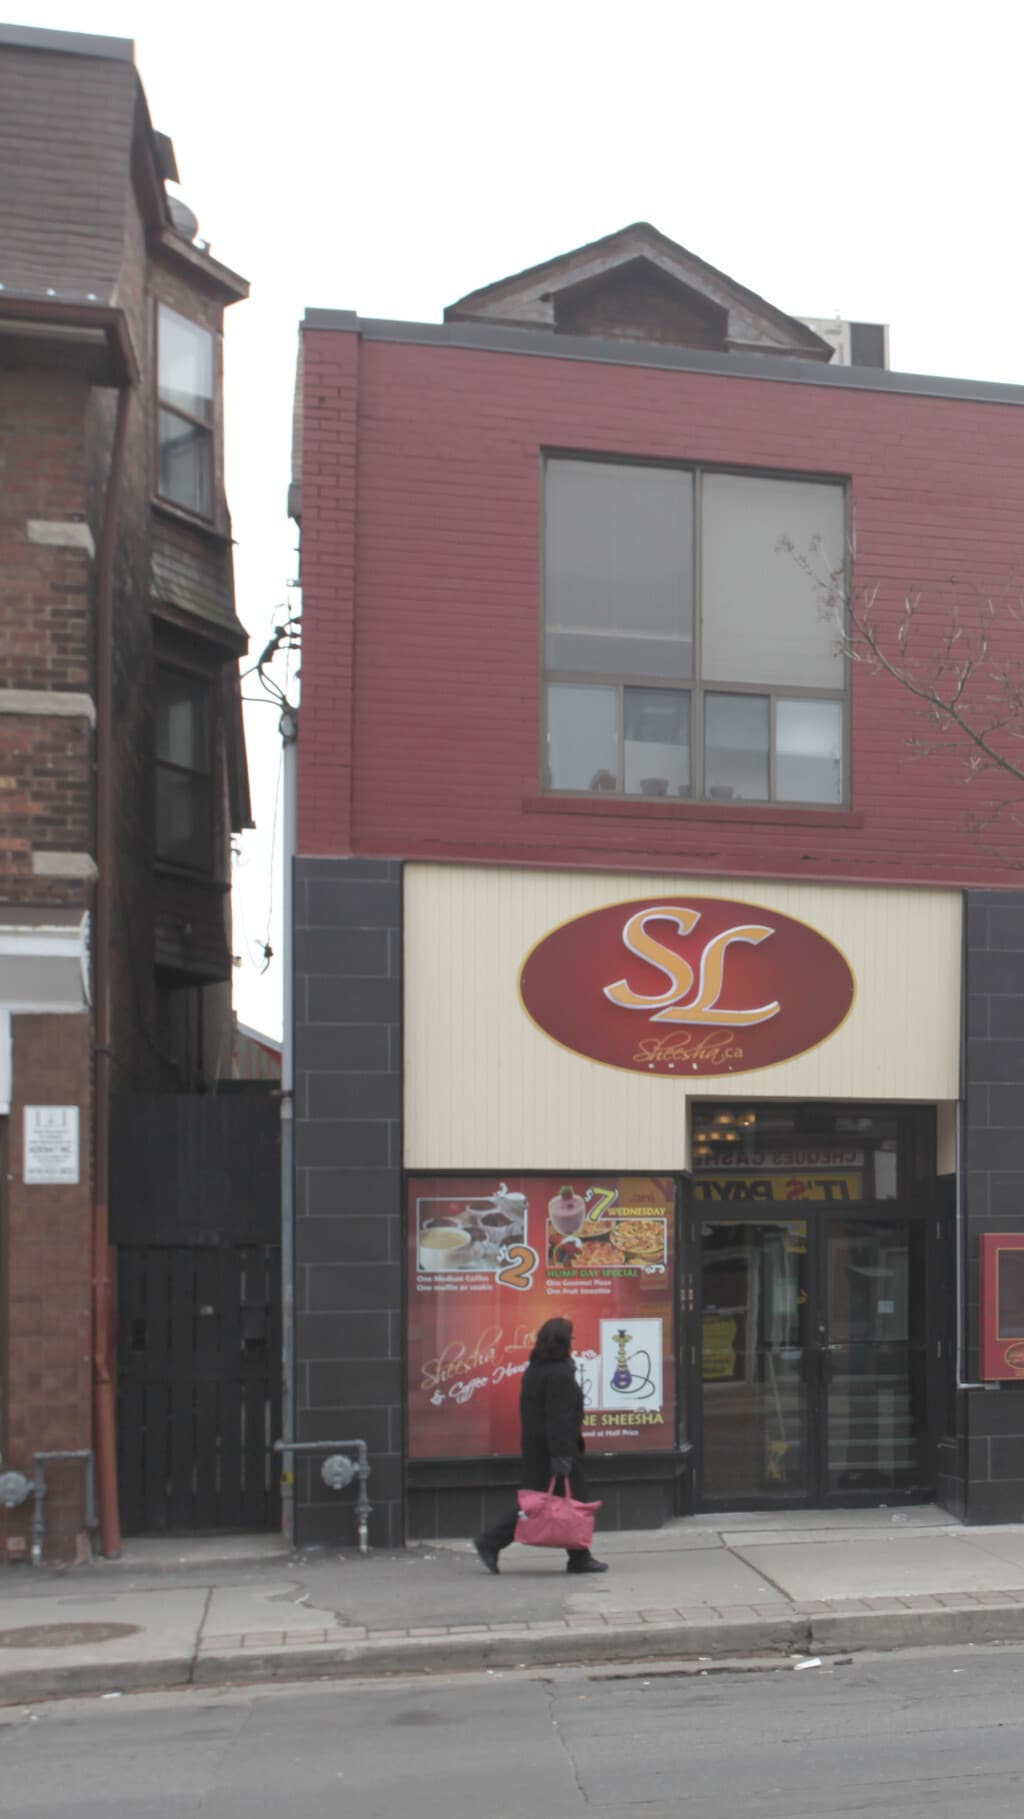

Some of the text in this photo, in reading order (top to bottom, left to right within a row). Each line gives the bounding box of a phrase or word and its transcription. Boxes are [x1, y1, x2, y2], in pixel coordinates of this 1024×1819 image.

[603, 906, 781, 1027] SL
[585, 1188, 619, 1222] $7
[497, 1244, 539, 1290] $2
[601, 1413, 664, 1426] SHEESHA
